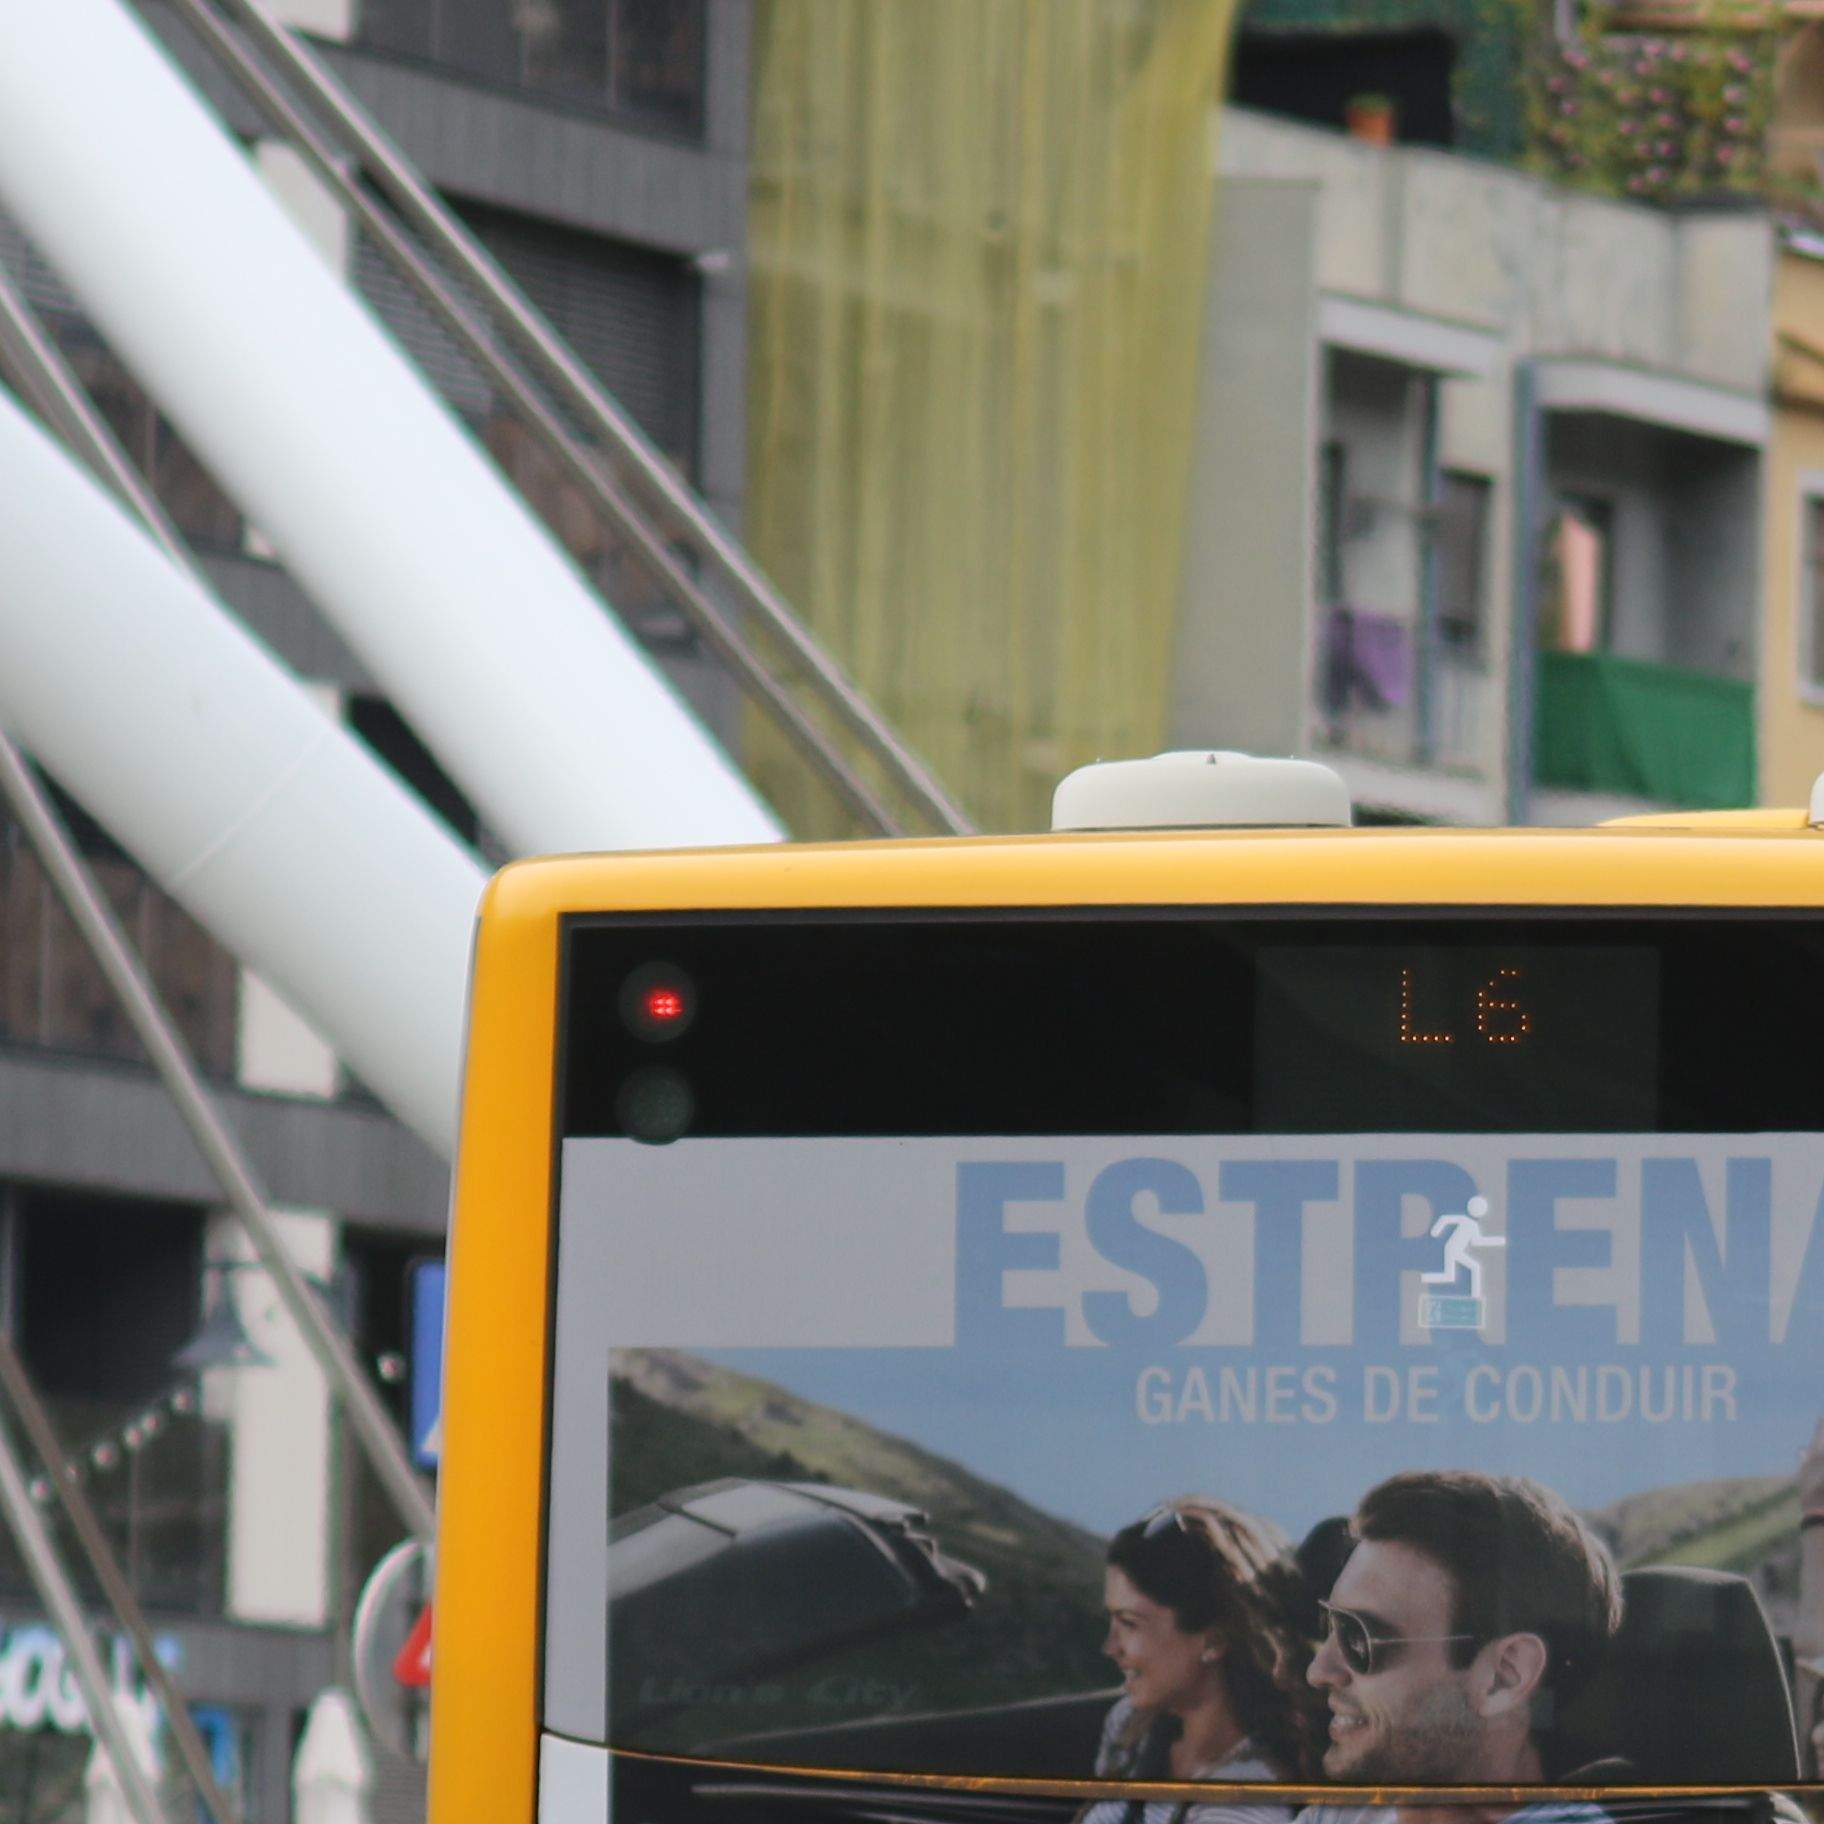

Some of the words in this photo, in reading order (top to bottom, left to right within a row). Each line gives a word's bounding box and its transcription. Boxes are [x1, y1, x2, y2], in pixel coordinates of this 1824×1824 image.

[1399, 967, 1529, 1044] L6
[1135, 1364, 1337, 1423] GANES
[1364, 1364, 1445, 1422] DE
[1464, 1363, 1738, 1422] CONDUIR
